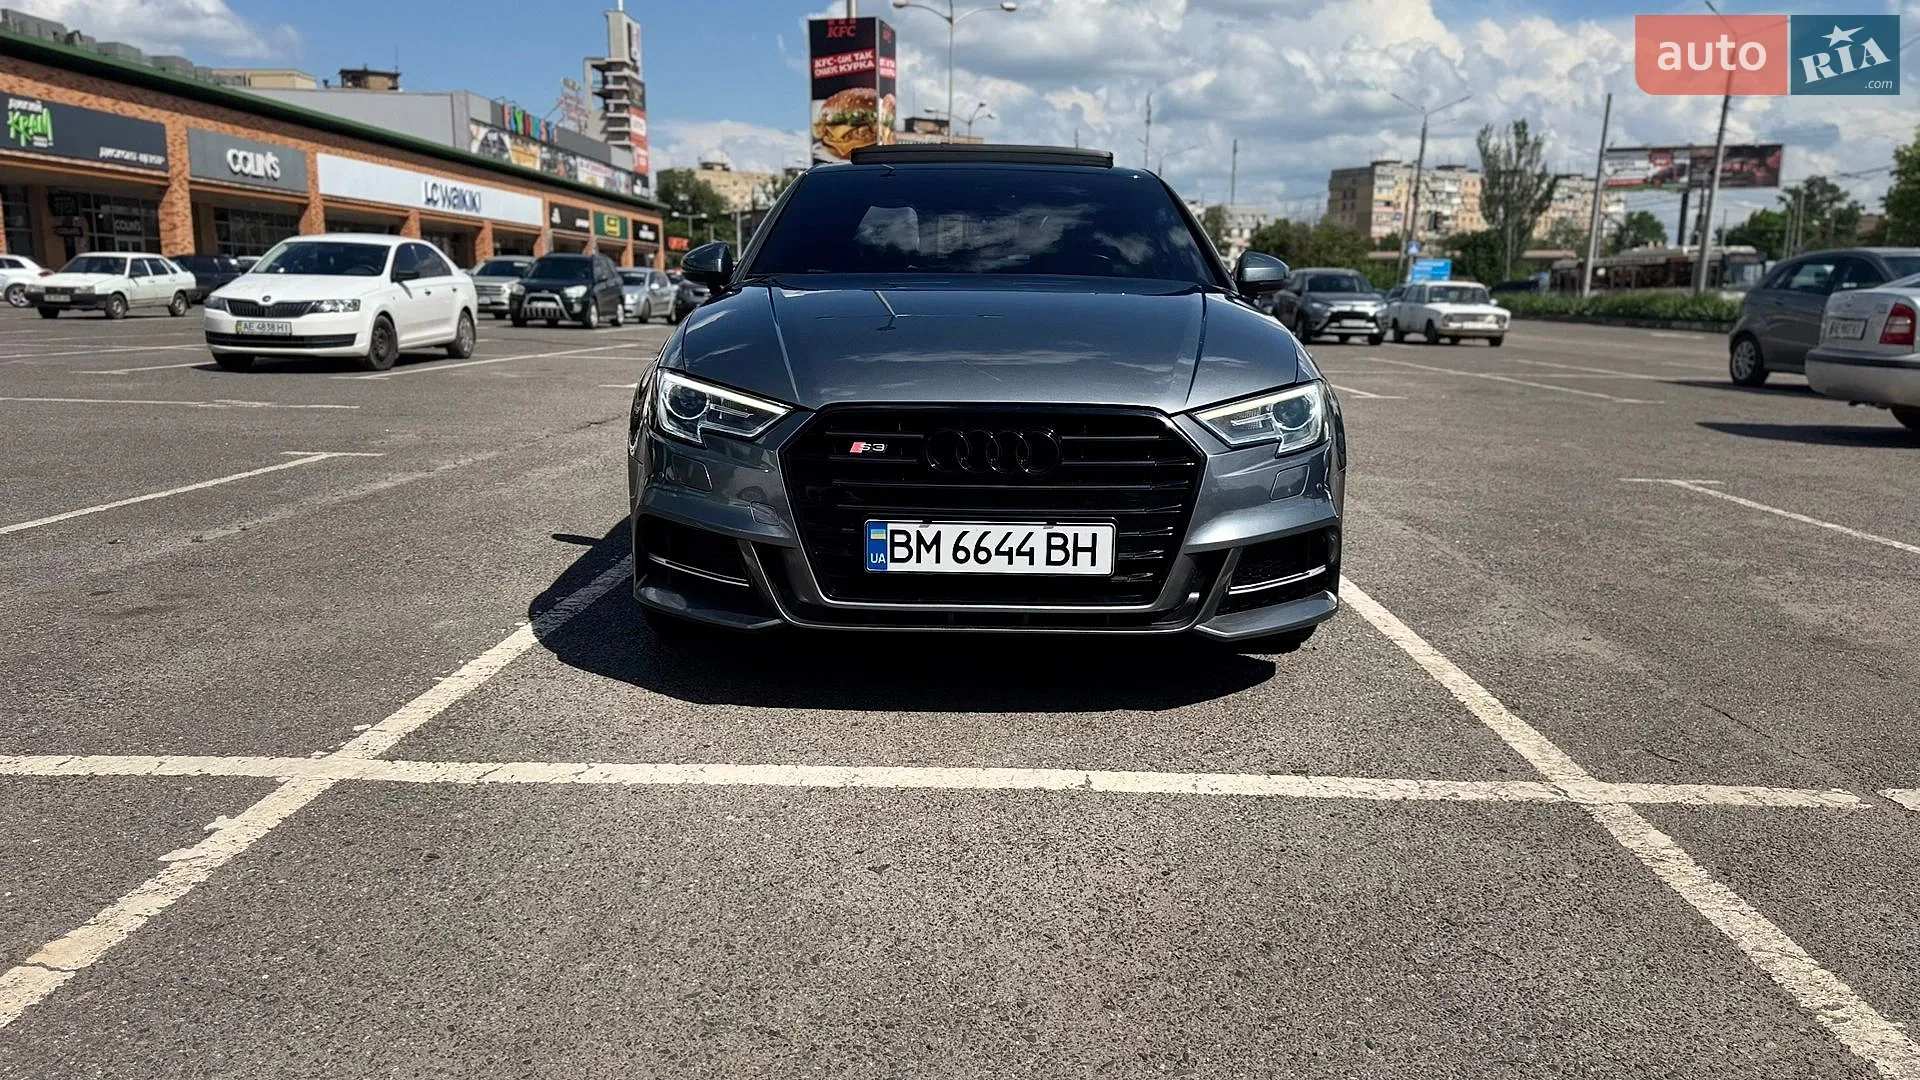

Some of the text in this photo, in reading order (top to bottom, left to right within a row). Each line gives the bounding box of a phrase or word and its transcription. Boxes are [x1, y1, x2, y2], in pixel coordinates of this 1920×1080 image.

[826, 26, 856, 38] KFC
[839, 59, 875, 73] КУРКА
[226, 149, 281, 178] COLIN'S
[889, 529, 1098, 567] BM 6644 BH
[870, 553, 886, 564] UA
